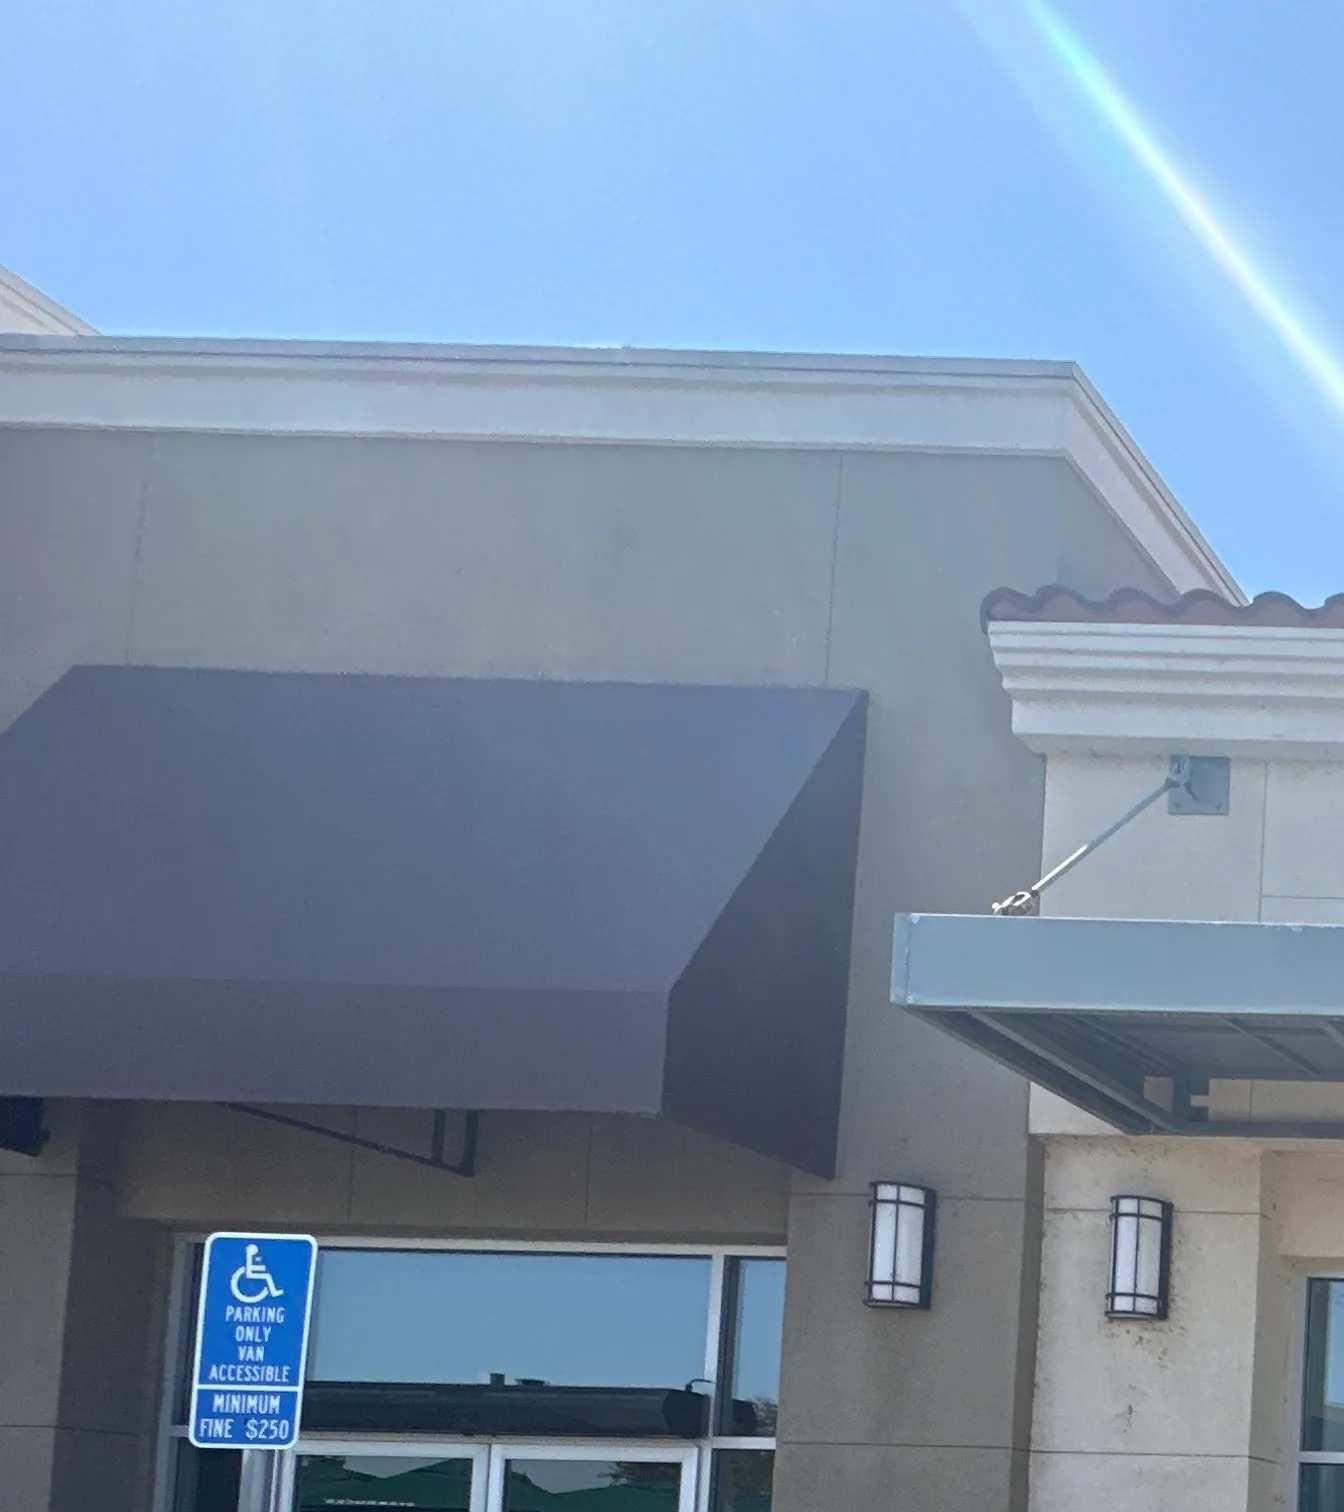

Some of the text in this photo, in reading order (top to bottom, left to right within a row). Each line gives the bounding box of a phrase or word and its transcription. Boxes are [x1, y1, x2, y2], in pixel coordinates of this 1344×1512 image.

[225, 1305, 286, 1323] PARKING
[235, 1325, 272, 1342] ONLY
[237, 1346, 265, 1362] VAN
[208, 1364, 291, 1382] ACCESSIBLE
[212, 1394, 281, 1414] MINIMUM
[200, 1418, 290, 1440] FINE $250
